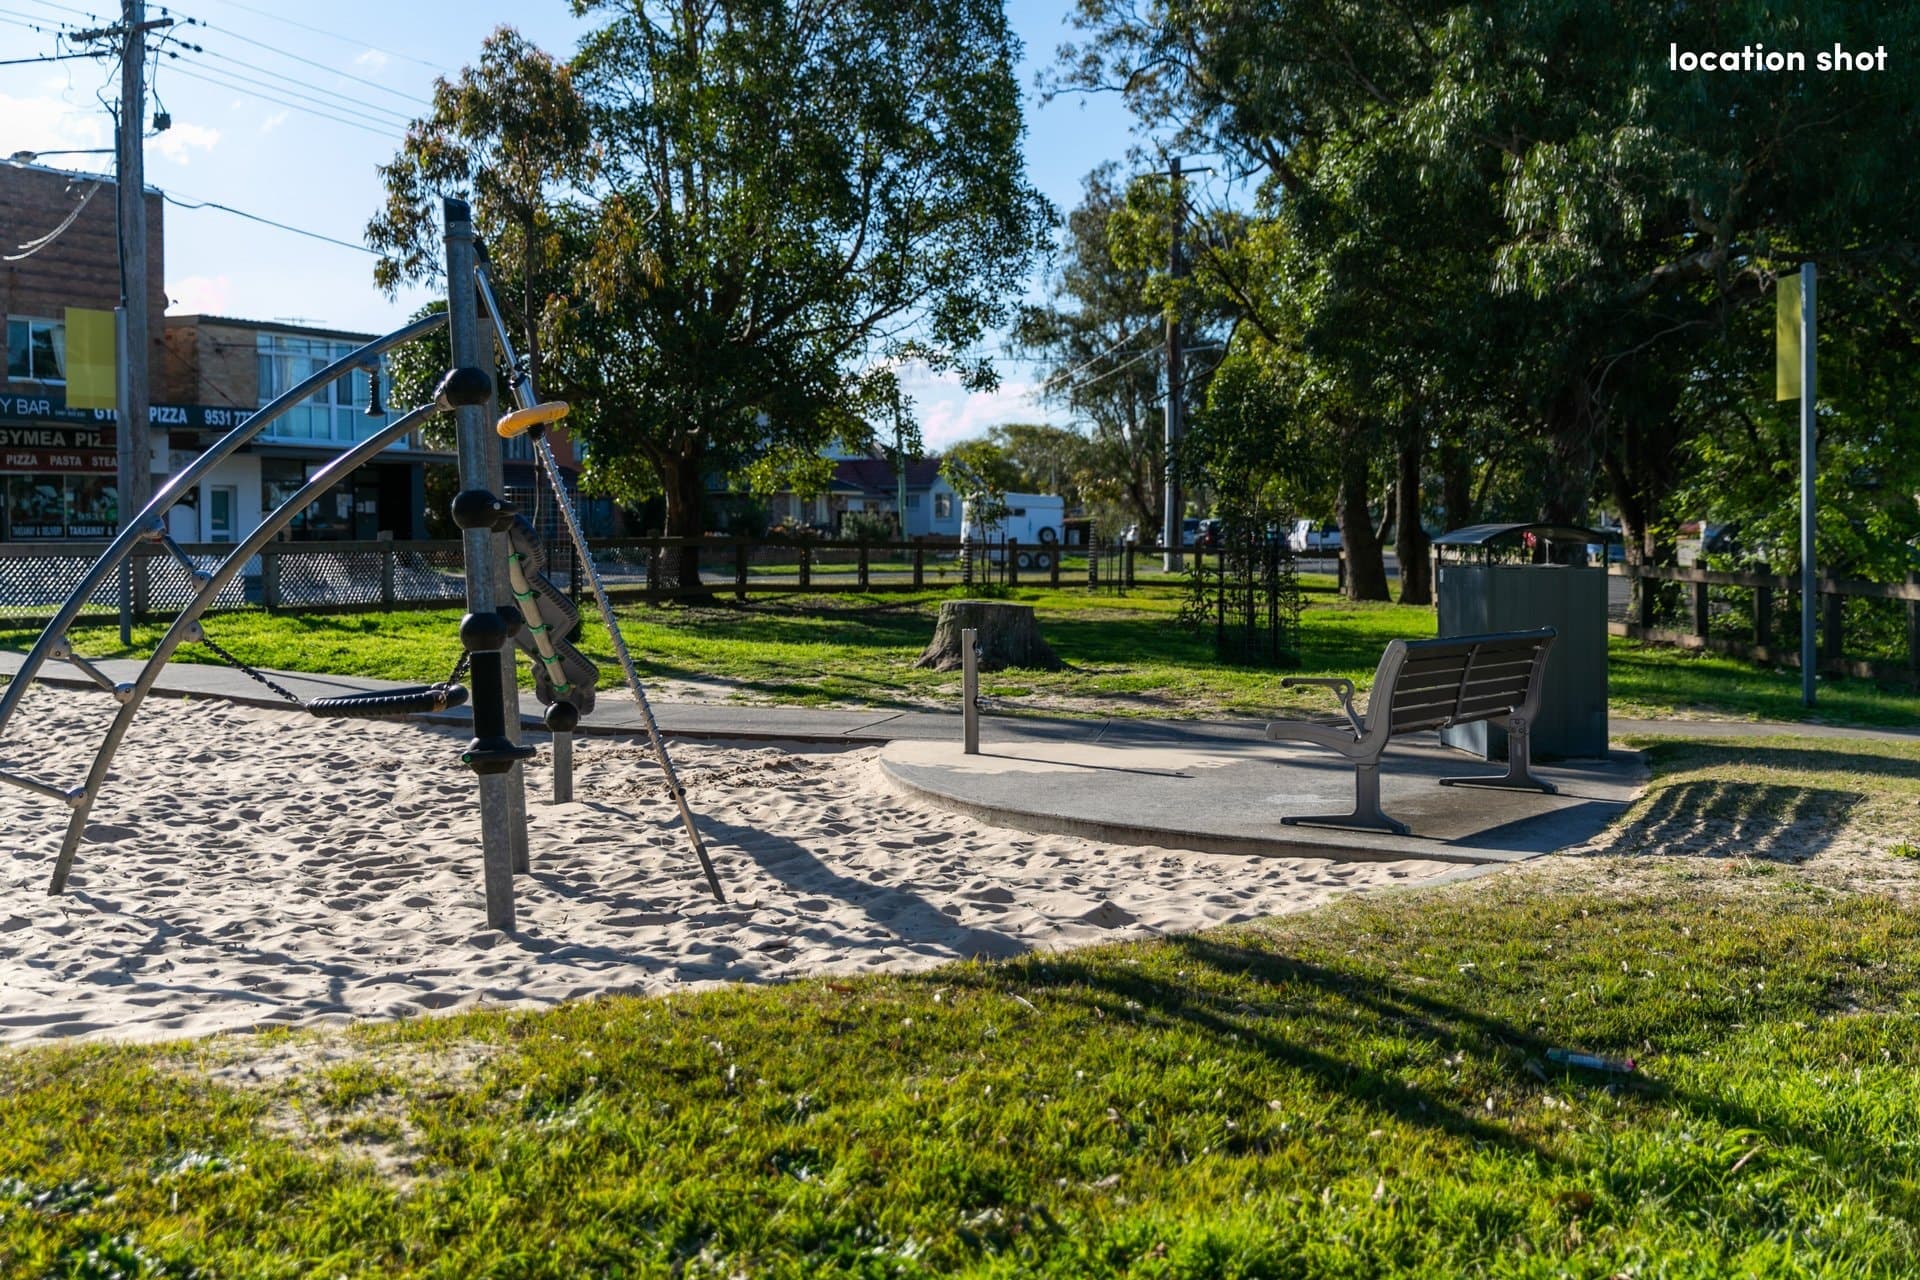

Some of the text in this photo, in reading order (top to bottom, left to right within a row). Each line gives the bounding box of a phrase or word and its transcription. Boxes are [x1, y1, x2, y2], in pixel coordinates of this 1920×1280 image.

[16, 398, 50, 416] BAR
[149, 406, 188, 424] PIZZA
[204, 409, 231, 426] 9531
[0, 430, 66, 446] GYMEA
[6, 454, 38, 465] PIZZA
[50, 455, 82, 466] PASTA
